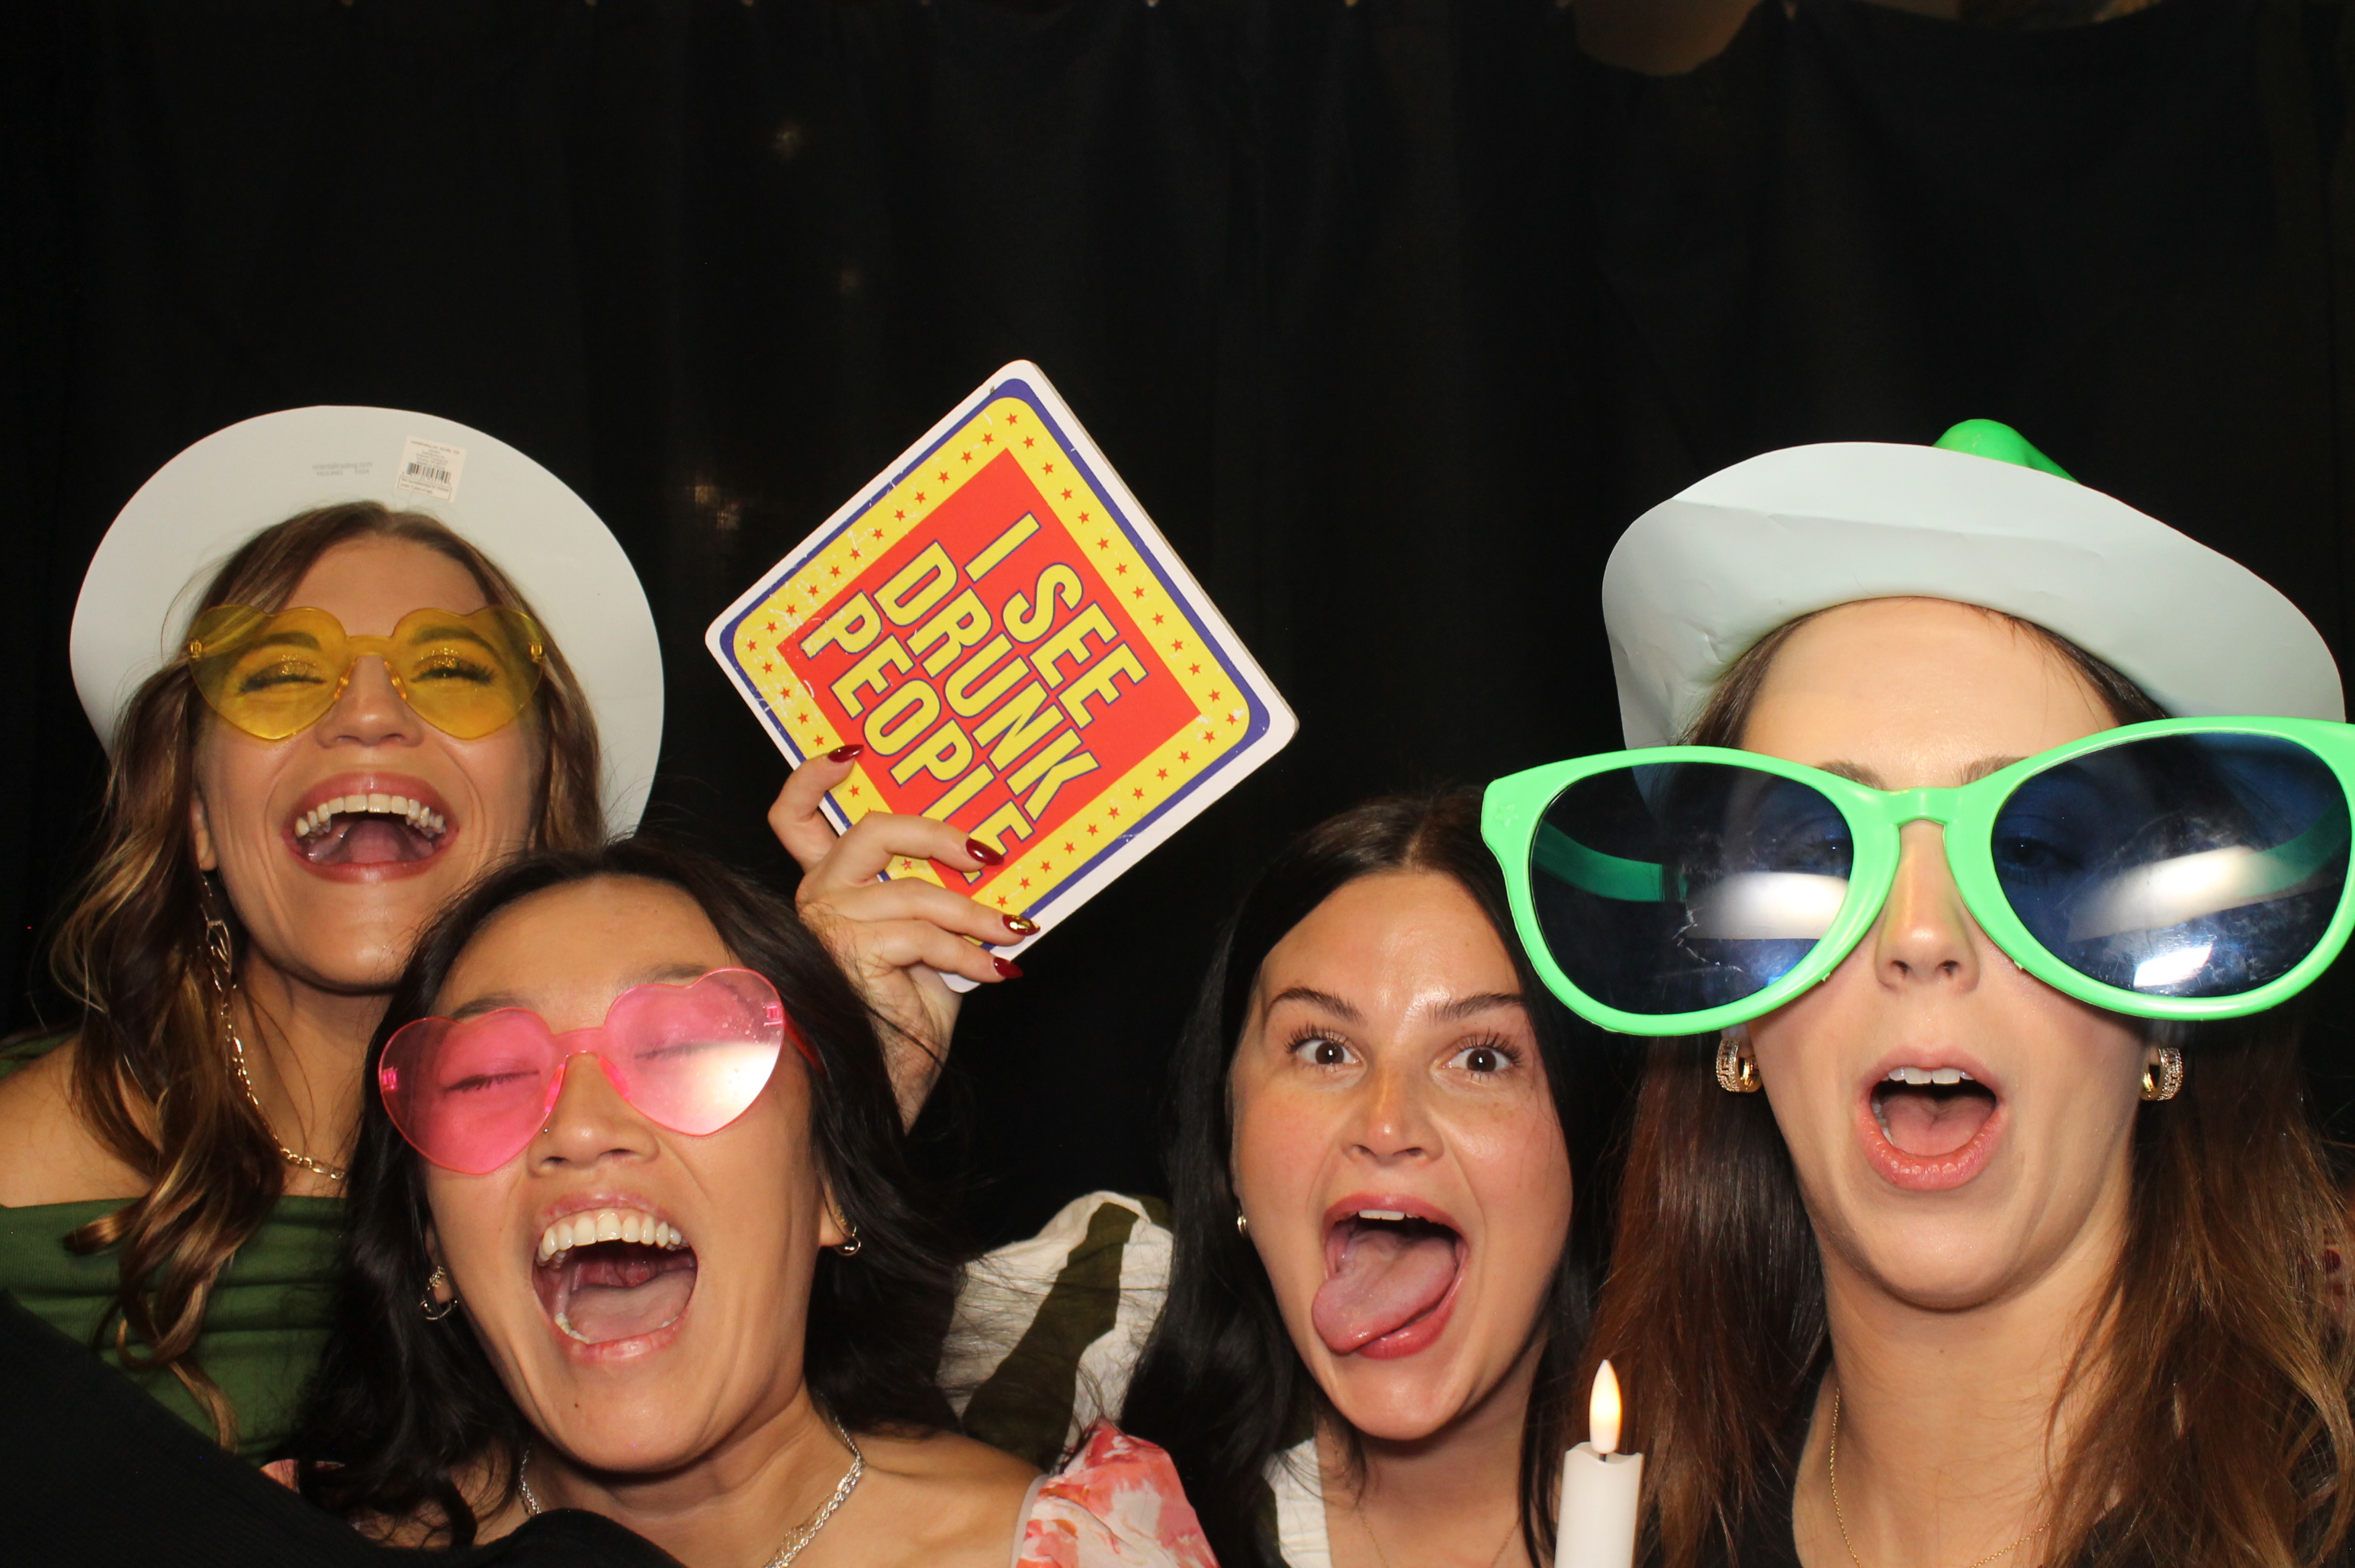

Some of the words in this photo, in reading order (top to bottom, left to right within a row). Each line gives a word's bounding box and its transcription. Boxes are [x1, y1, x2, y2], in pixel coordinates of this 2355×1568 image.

[873, 540, 1100, 823] DRUNK
[963, 511, 1041, 583] I
[1002, 562, 1149, 730] SEE
